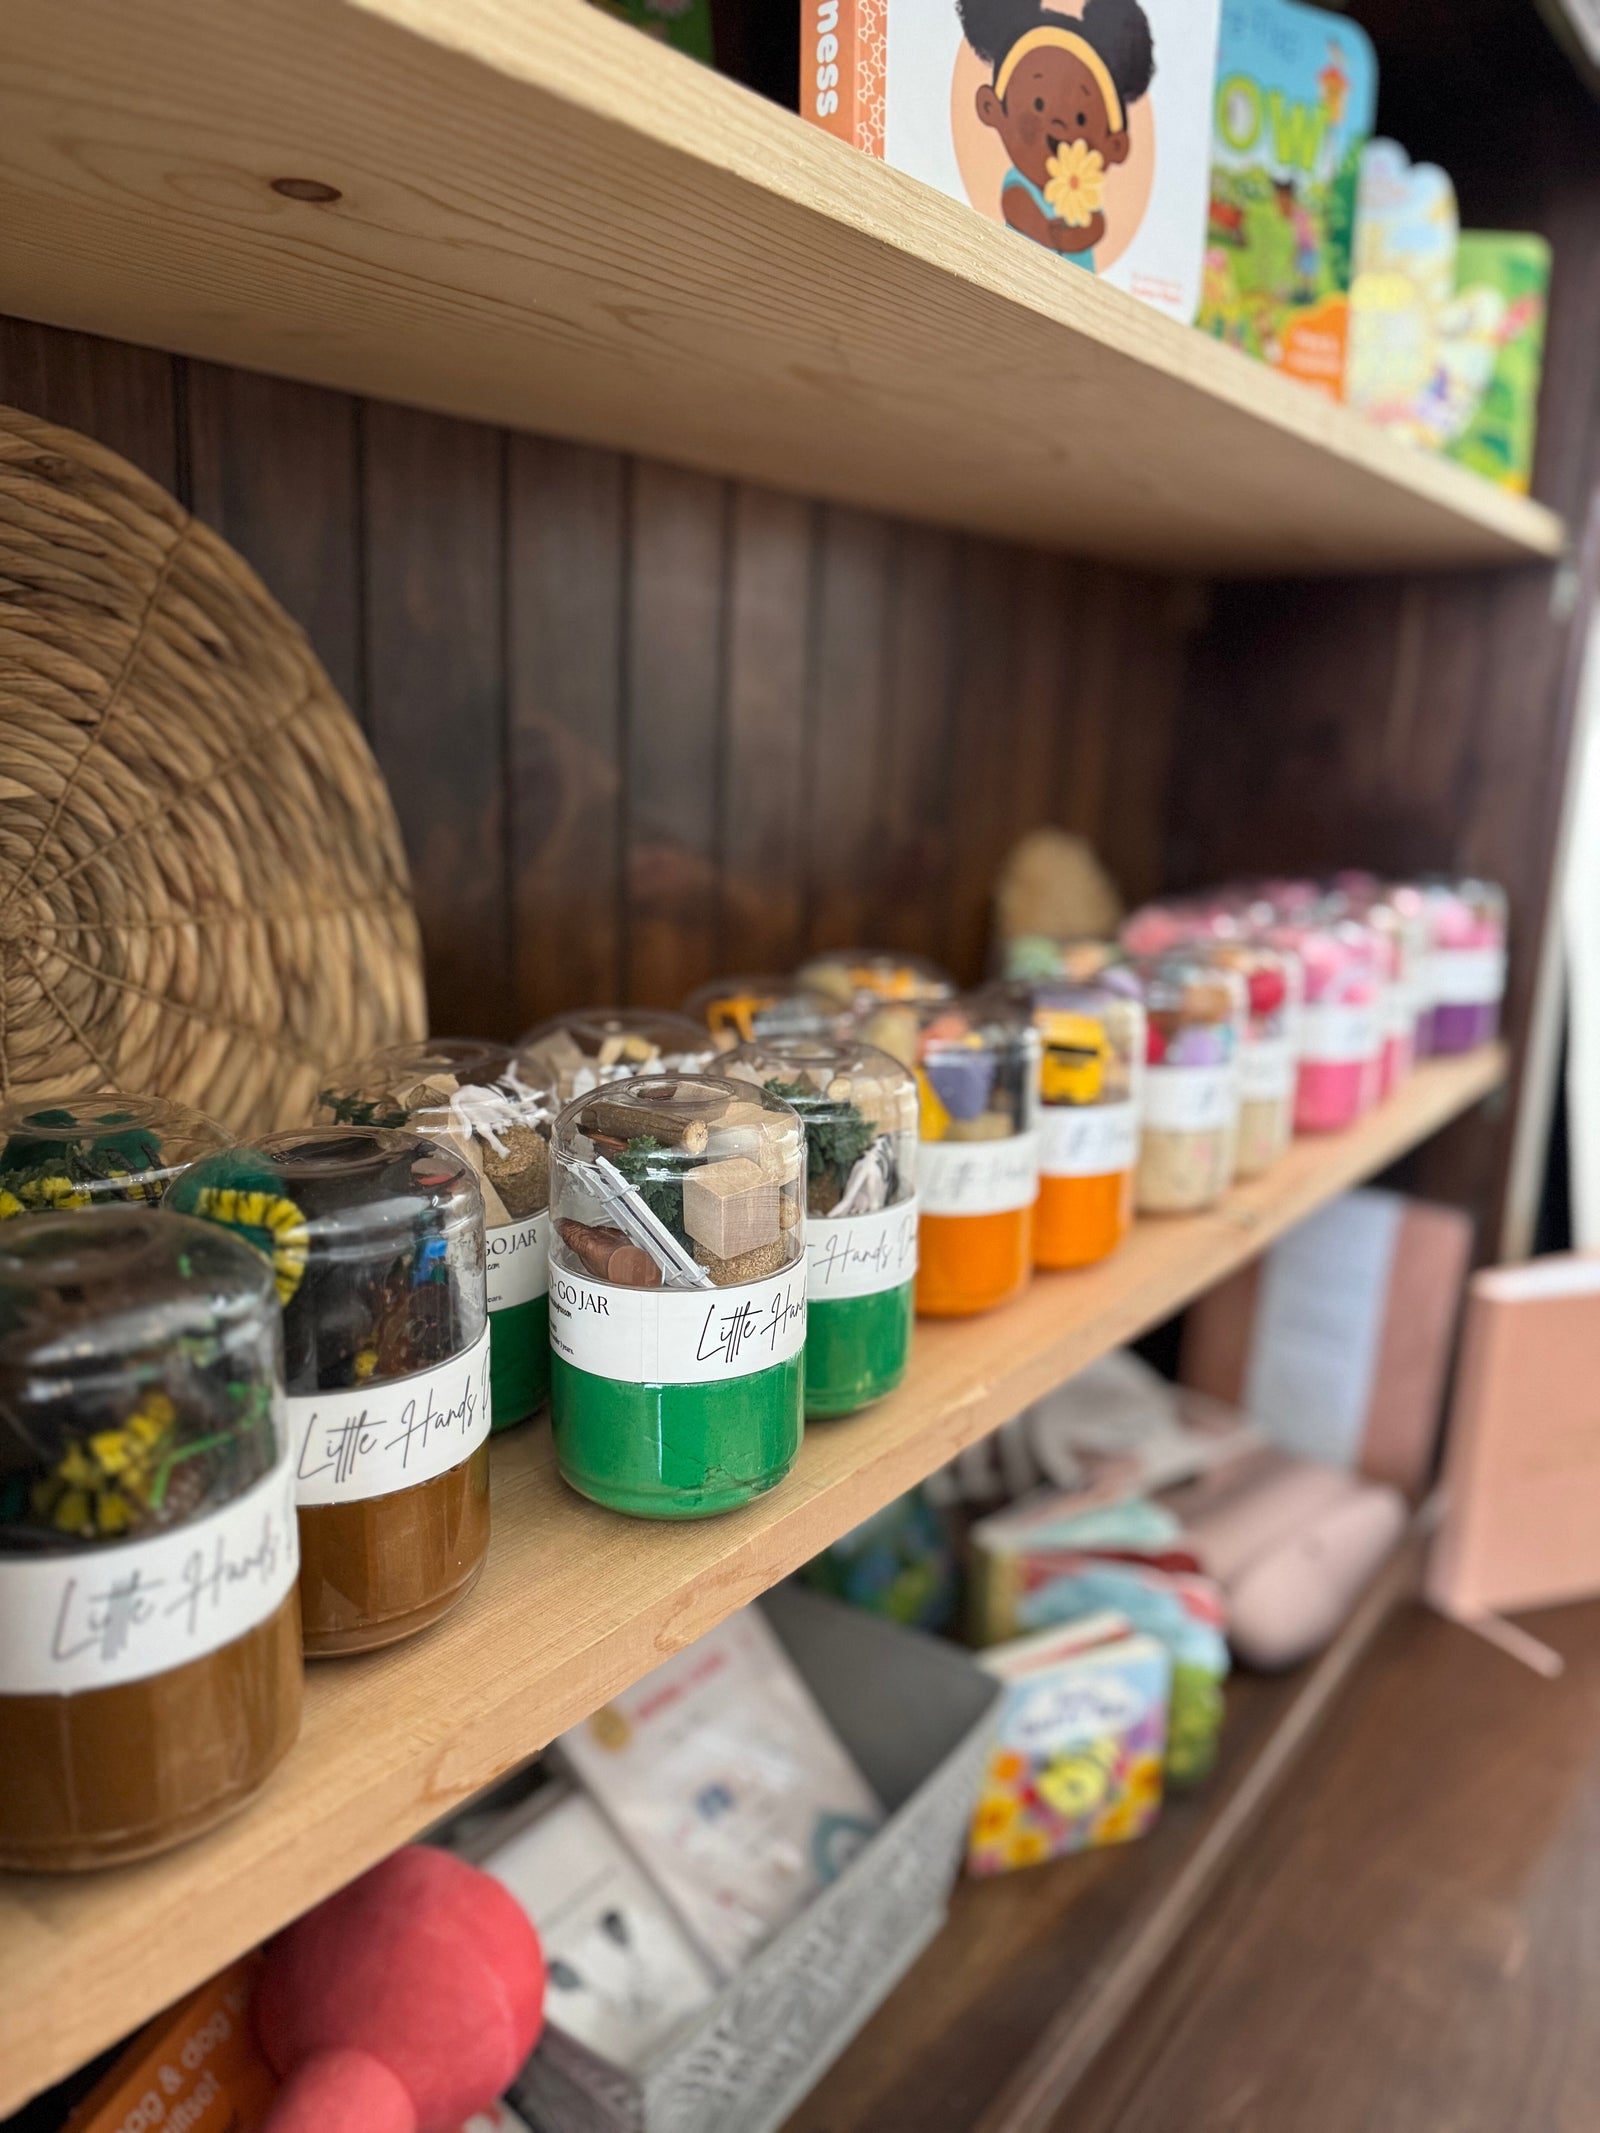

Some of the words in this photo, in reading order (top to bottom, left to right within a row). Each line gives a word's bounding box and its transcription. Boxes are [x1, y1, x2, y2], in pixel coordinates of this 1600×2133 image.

[508, 1228, 538, 1255] JAR
[812, 1229, 894, 1286] Hands
[578, 1290, 610, 1317] JAR
[697, 1300, 763, 1363] Little
[297, 1409, 387, 1484] Little
[384, 1374, 478, 1469] Hands
